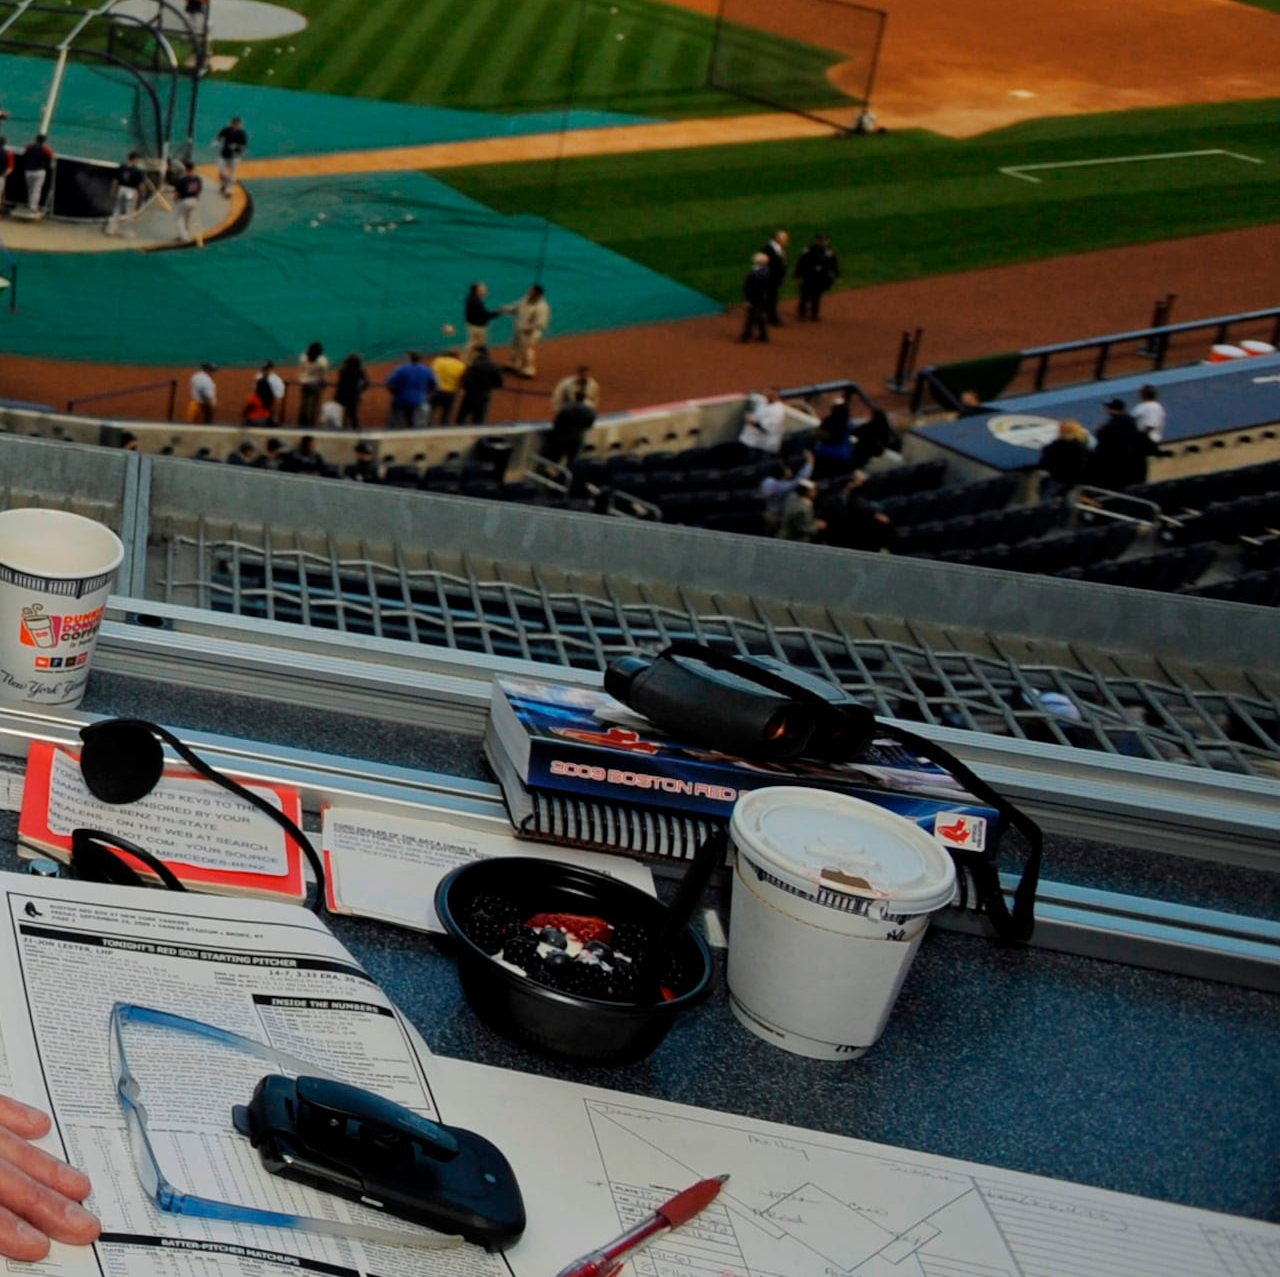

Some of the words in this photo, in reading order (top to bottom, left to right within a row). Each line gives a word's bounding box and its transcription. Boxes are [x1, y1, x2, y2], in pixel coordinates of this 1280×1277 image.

[1, 669, 28, 690] New
[27, 680, 61, 699] York
[550, 760, 607, 781] 2009
[607, 769, 693, 795] BOSTON
[694, 782, 736, 802] RED
[51, 787, 153, 821] MERCEDES-BENZ
[155, 814, 219, 831] TRI-STATE
[53, 778, 82, 794] GAME
[195, 811, 211, 819] BY
[215, 813, 251, 824] YOUR
[178, 795, 211, 806] KEYS
[216, 800, 232, 809] TO
[235, 804, 261, 814] THE
[116, 818, 134, 828] ON
[139, 824, 162, 833] THE
[165, 829, 193, 839] WEB
[197, 833, 213, 842] AT
[215, 837, 269, 852] SEARCH
[117, 829, 142, 840] DOT
[185, 844, 221, 855] YOUR
[224, 849, 279, 864] SOURCE
[155, 850, 266, 871] MERCEDES-BENZ
[102, 938, 156, 953] TONIGHT'S
[156, 946, 177, 956] RED
[178, 948, 200, 959] SOX
[200, 950, 251, 965] STARTING
[252, 956, 298, 968] PITCHER
[271, 997, 307, 1008] INSIDE
[310, 1000, 329, 1009] THE
[331, 1000, 379, 1014] NUMBERS
[161, 1238, 244, 1255] BATTER-PITCHER
[246, 1249, 300, 1266] MATCHUPS
